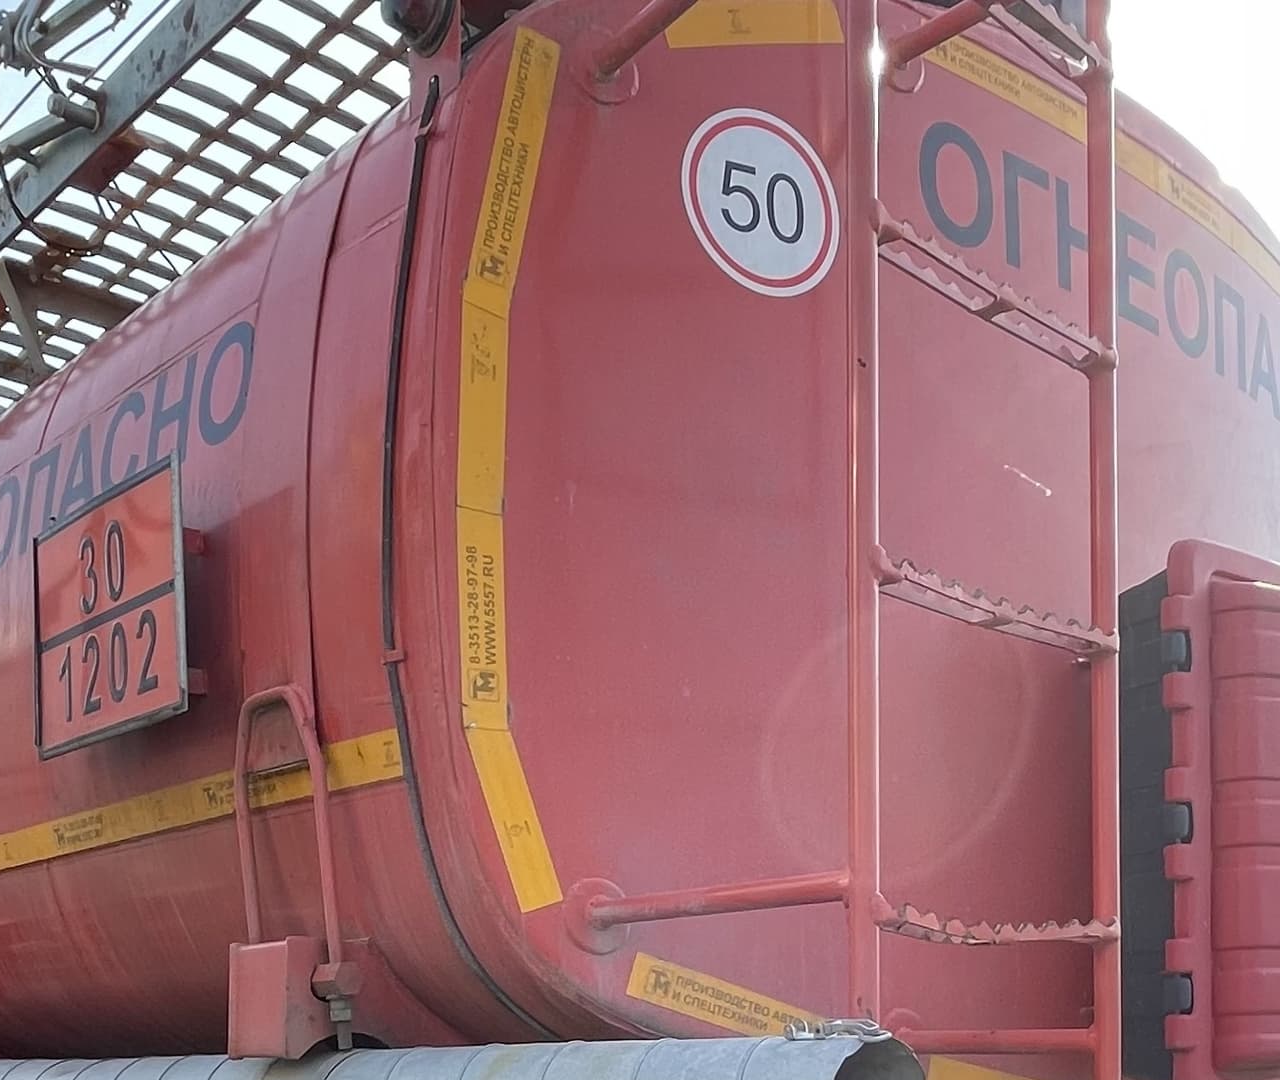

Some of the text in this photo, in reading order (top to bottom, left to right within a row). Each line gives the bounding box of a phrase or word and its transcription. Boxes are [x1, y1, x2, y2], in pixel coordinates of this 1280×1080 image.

[483, 36, 536, 249] ПРОИЗВОДСТВО АВТОЦИСТЕРН
[498, 142, 530, 256] И СПЕЦТЕХНИКИ
[720, 160, 804, 245] 50
[78, 519, 125, 614] 30
[465, 545, 481, 665] 8-3513-28-97-98
[482, 554, 497, 665] WWW.5557.RU
[58, 609, 159, 722] 1202
[676, 975, 771, 1017] ПРОИЗВОДСТВО
[683, 994, 768, 1032] СПЕЦТЕХНИКИ
